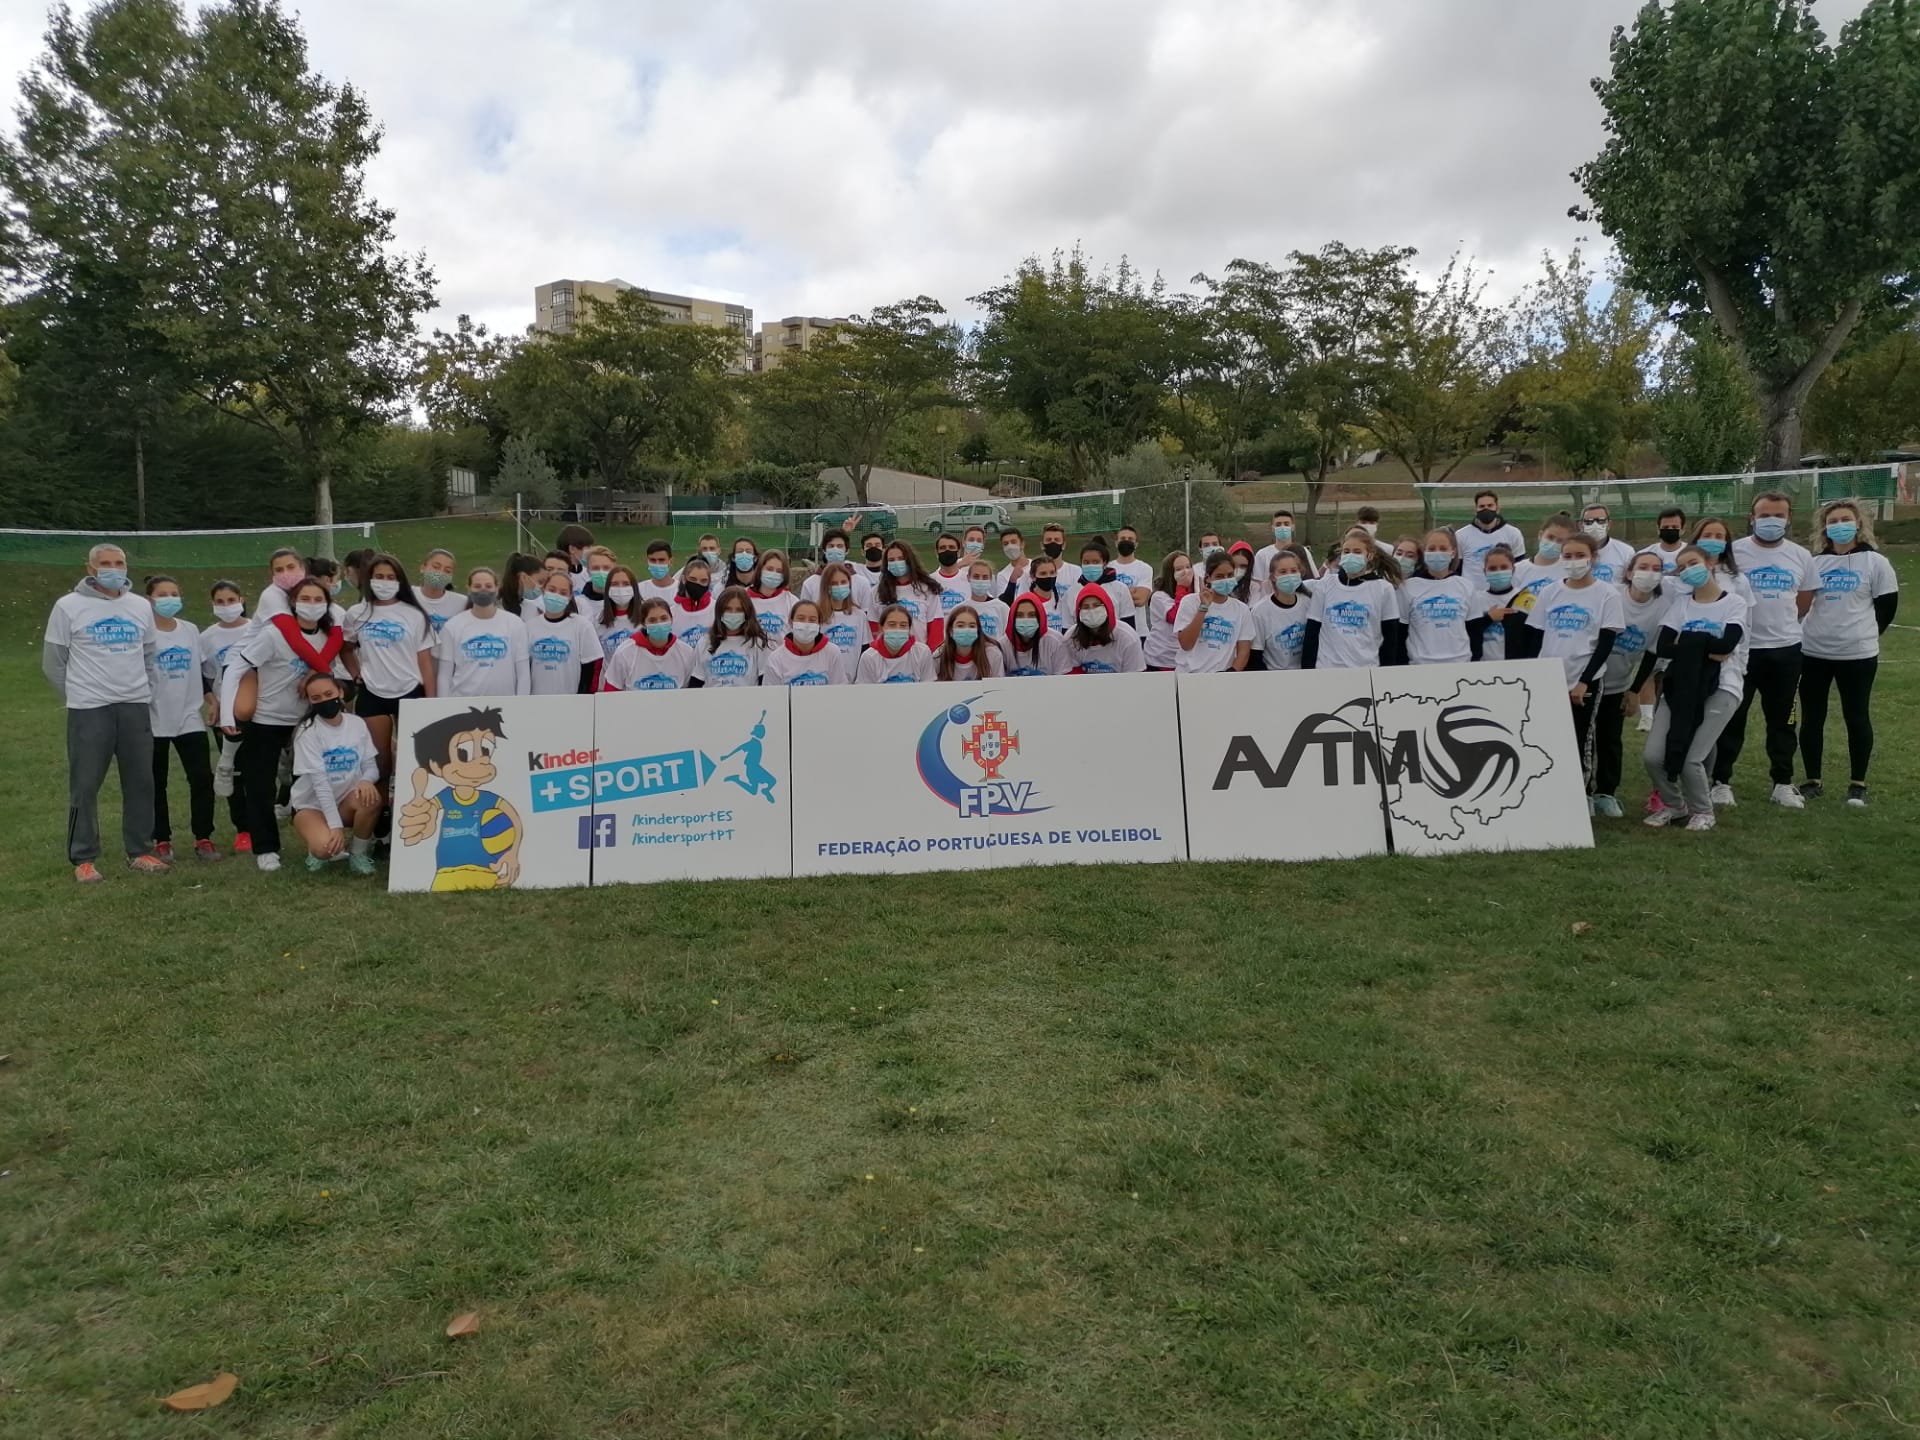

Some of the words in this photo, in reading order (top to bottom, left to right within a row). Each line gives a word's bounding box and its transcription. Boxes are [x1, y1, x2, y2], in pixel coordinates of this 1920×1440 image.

[568, 758, 684, 801] SPORT
[958, 781, 1033, 819] FPV
[818, 836, 921, 857] FEDERAÇÃO
[926, 831, 1044, 852] PORTUGUESA
[1048, 830, 1072, 844] DE
[1076, 828, 1162, 844] VOLEIBOL
